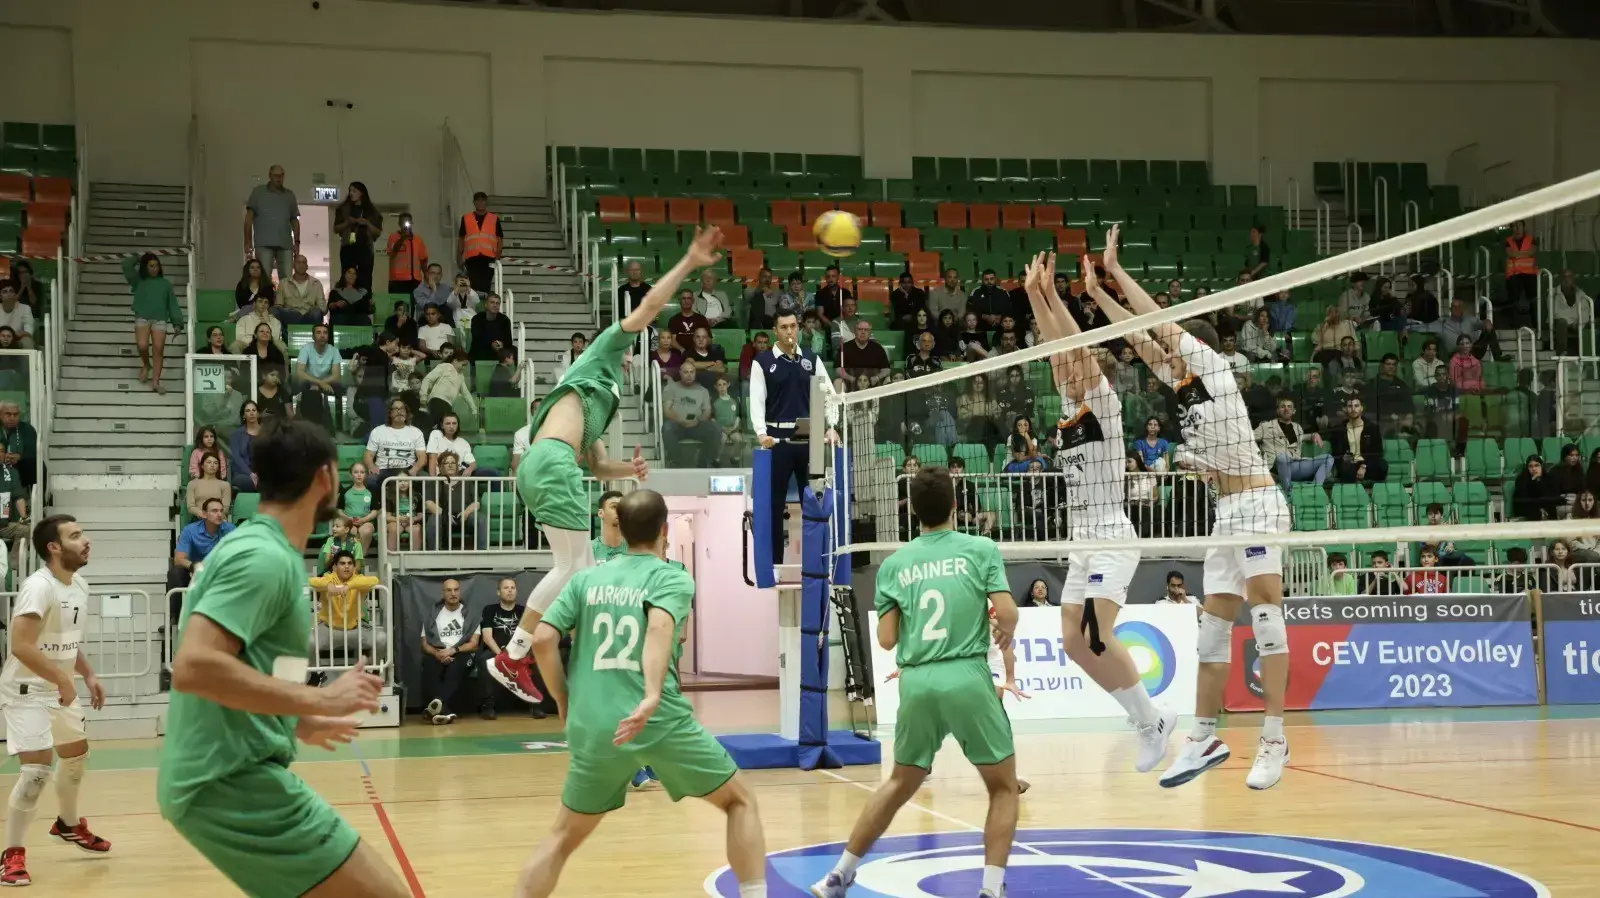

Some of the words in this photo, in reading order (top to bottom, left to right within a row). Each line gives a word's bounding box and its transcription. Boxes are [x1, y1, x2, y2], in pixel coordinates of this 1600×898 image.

[197, 367, 221, 377] שער
[203, 379, 216, 390] ב
[898, 557, 969, 588] MAINER
[73, 606, 79, 624] 7
[920, 589, 947, 641] 2
[1284, 604, 1333, 620] kets
[1341, 602, 1428, 622] coming
[1436, 603, 1493, 617] soon
[593, 612, 641, 671] 22
[1312, 641, 1369, 666] CEV
[1378, 639, 1523, 668] EuroVolley
[1388, 673, 1453, 698] 2023
